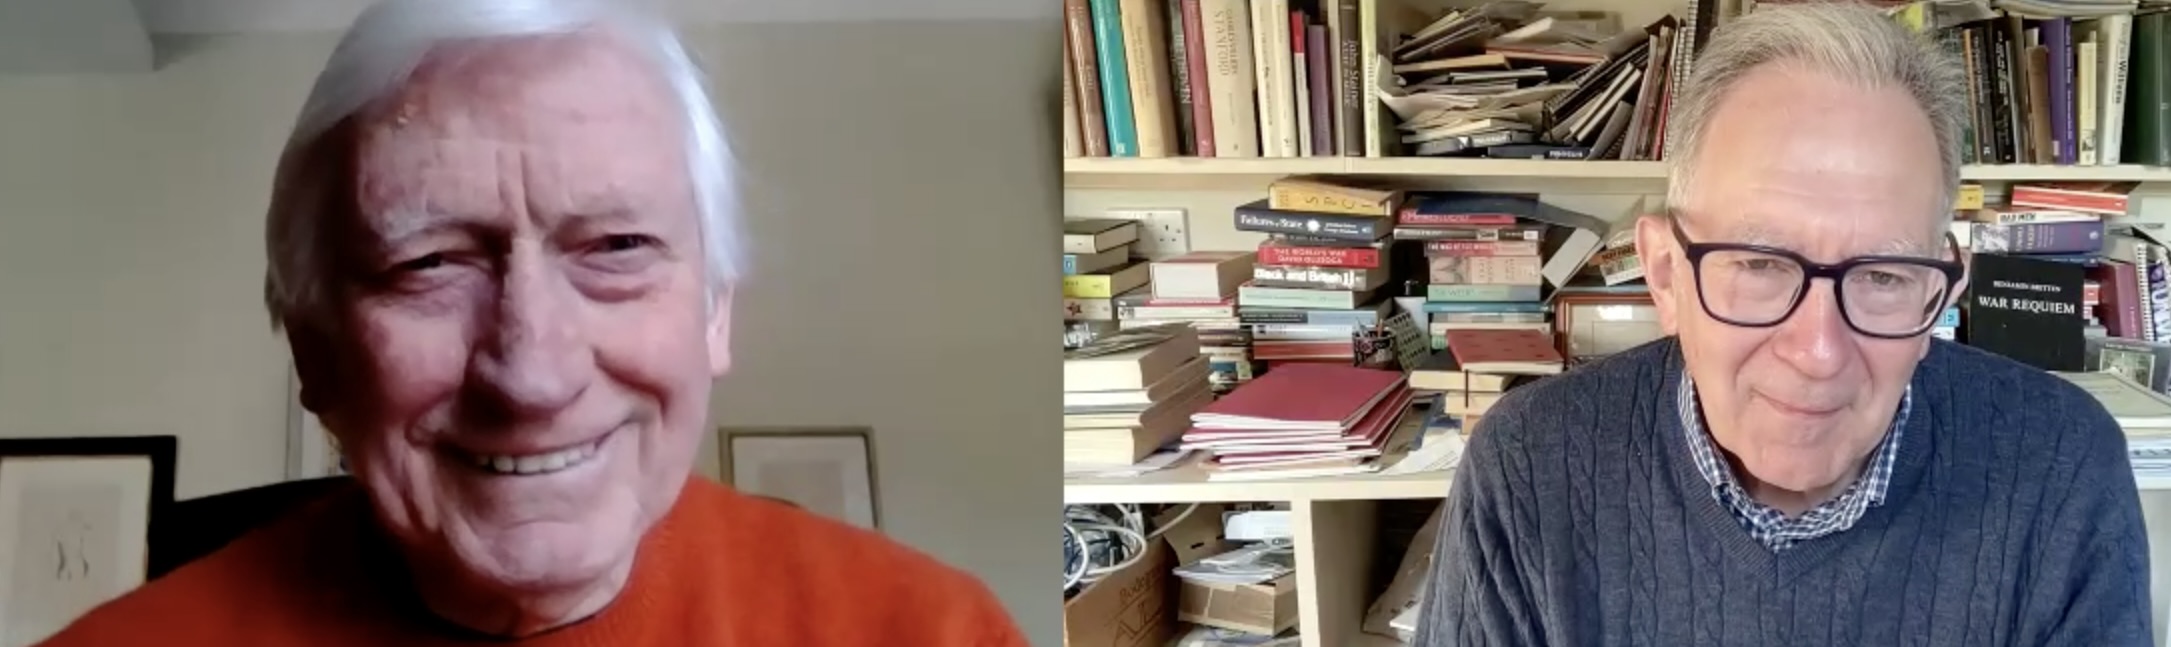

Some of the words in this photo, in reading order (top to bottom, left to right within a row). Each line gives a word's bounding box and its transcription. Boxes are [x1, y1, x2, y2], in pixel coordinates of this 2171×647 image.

[1214, 9, 1229, 76] STANFORD
[1280, 217, 1303, 229] State
[1253, 267, 1285, 280] Black
[1286, 270, 1307, 281] and
[1308, 270, 1343, 283] British
[1978, 295, 2008, 309] WAR
[2011, 298, 2075, 315] REQUIEM
